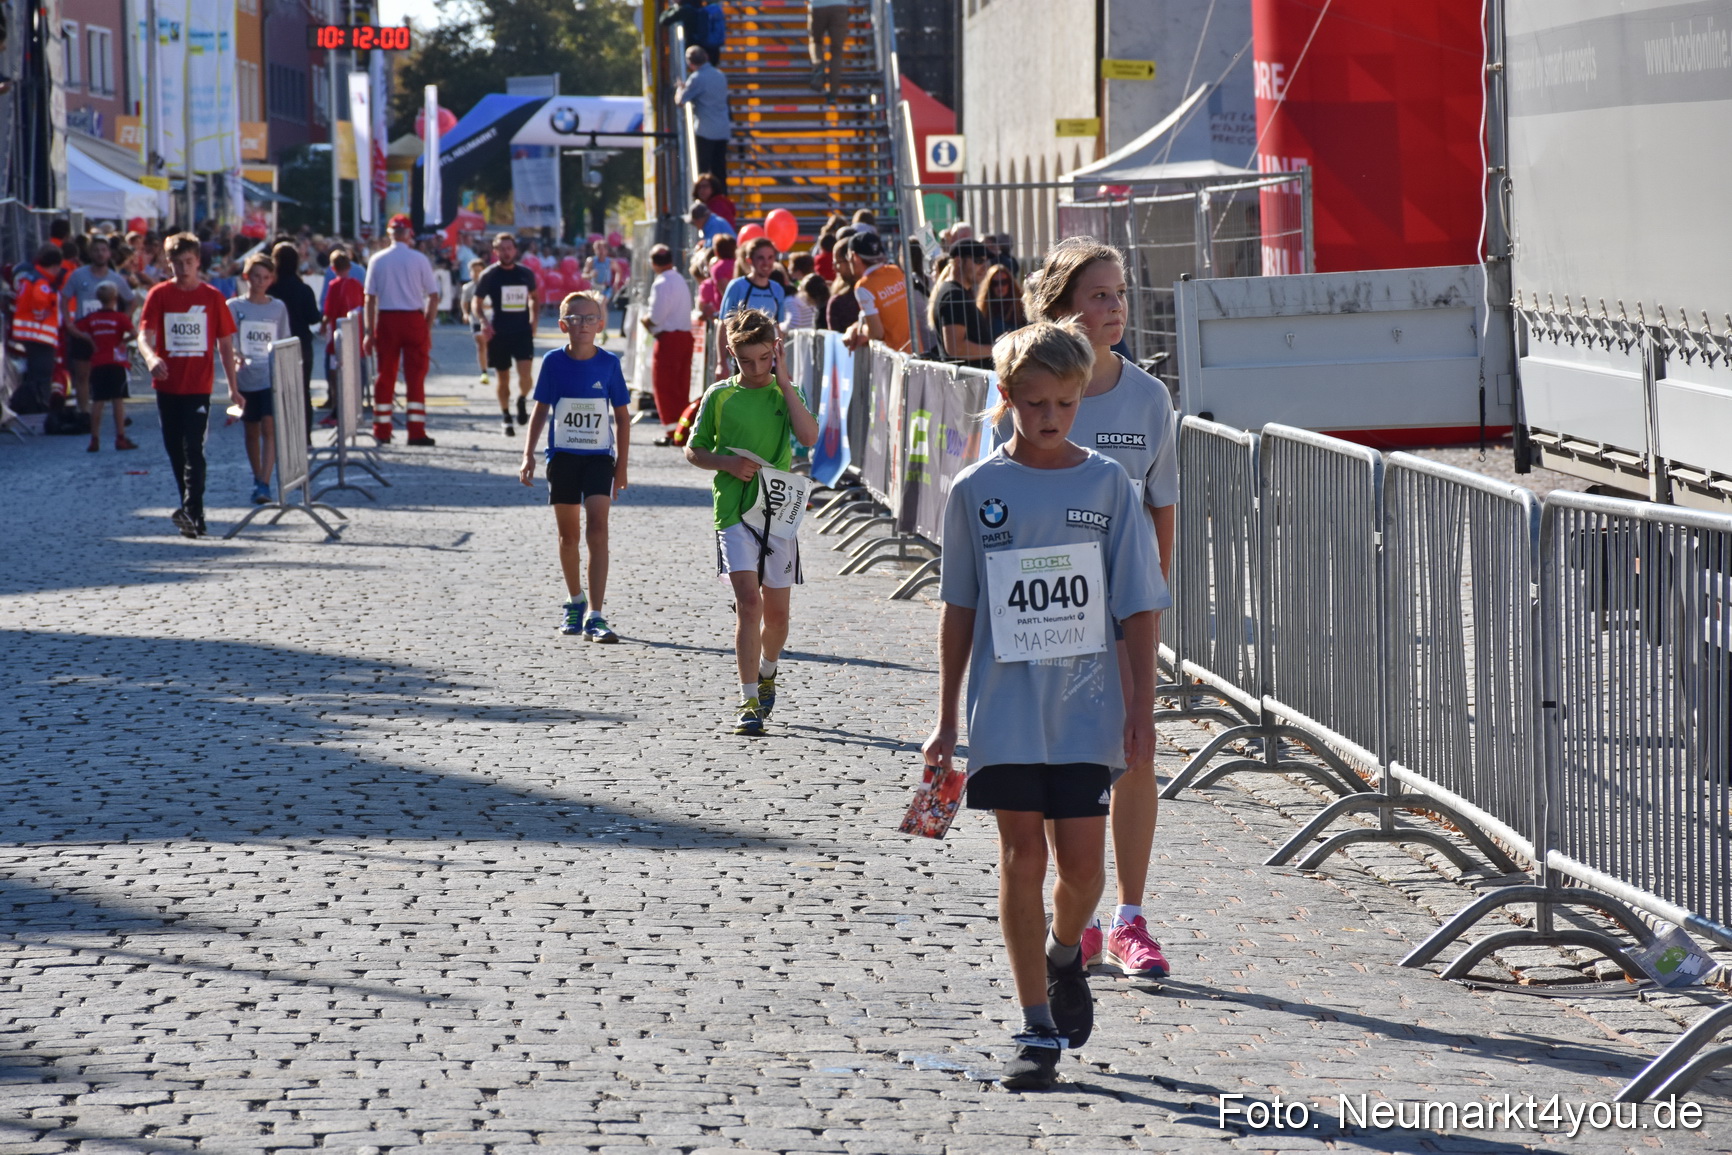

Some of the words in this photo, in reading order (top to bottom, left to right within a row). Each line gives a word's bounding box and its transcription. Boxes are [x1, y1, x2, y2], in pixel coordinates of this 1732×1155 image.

[1644, 16, 1732, 75] www.bockonline.
[171, 323, 201, 335] 4038
[246, 331, 272, 342] 4006
[563, 412, 602, 429] 4017
[566, 436, 598, 445] Johannes
[1096, 433, 1146, 447] BOCK
[785, 490, 804, 525] Leonhard
[1067, 509, 1112, 530] BOCK
[981, 531, 1014, 543] PARTL
[983, 539, 1014, 549] Neumarkt
[1021, 555, 1072, 570] BOCK
[1008, 575, 1089, 613] 4040
[1017, 617, 1042, 625] PARTL
[1043, 614, 1076, 623] Neumarkt
[1014, 627, 1085, 651] MARVIN
